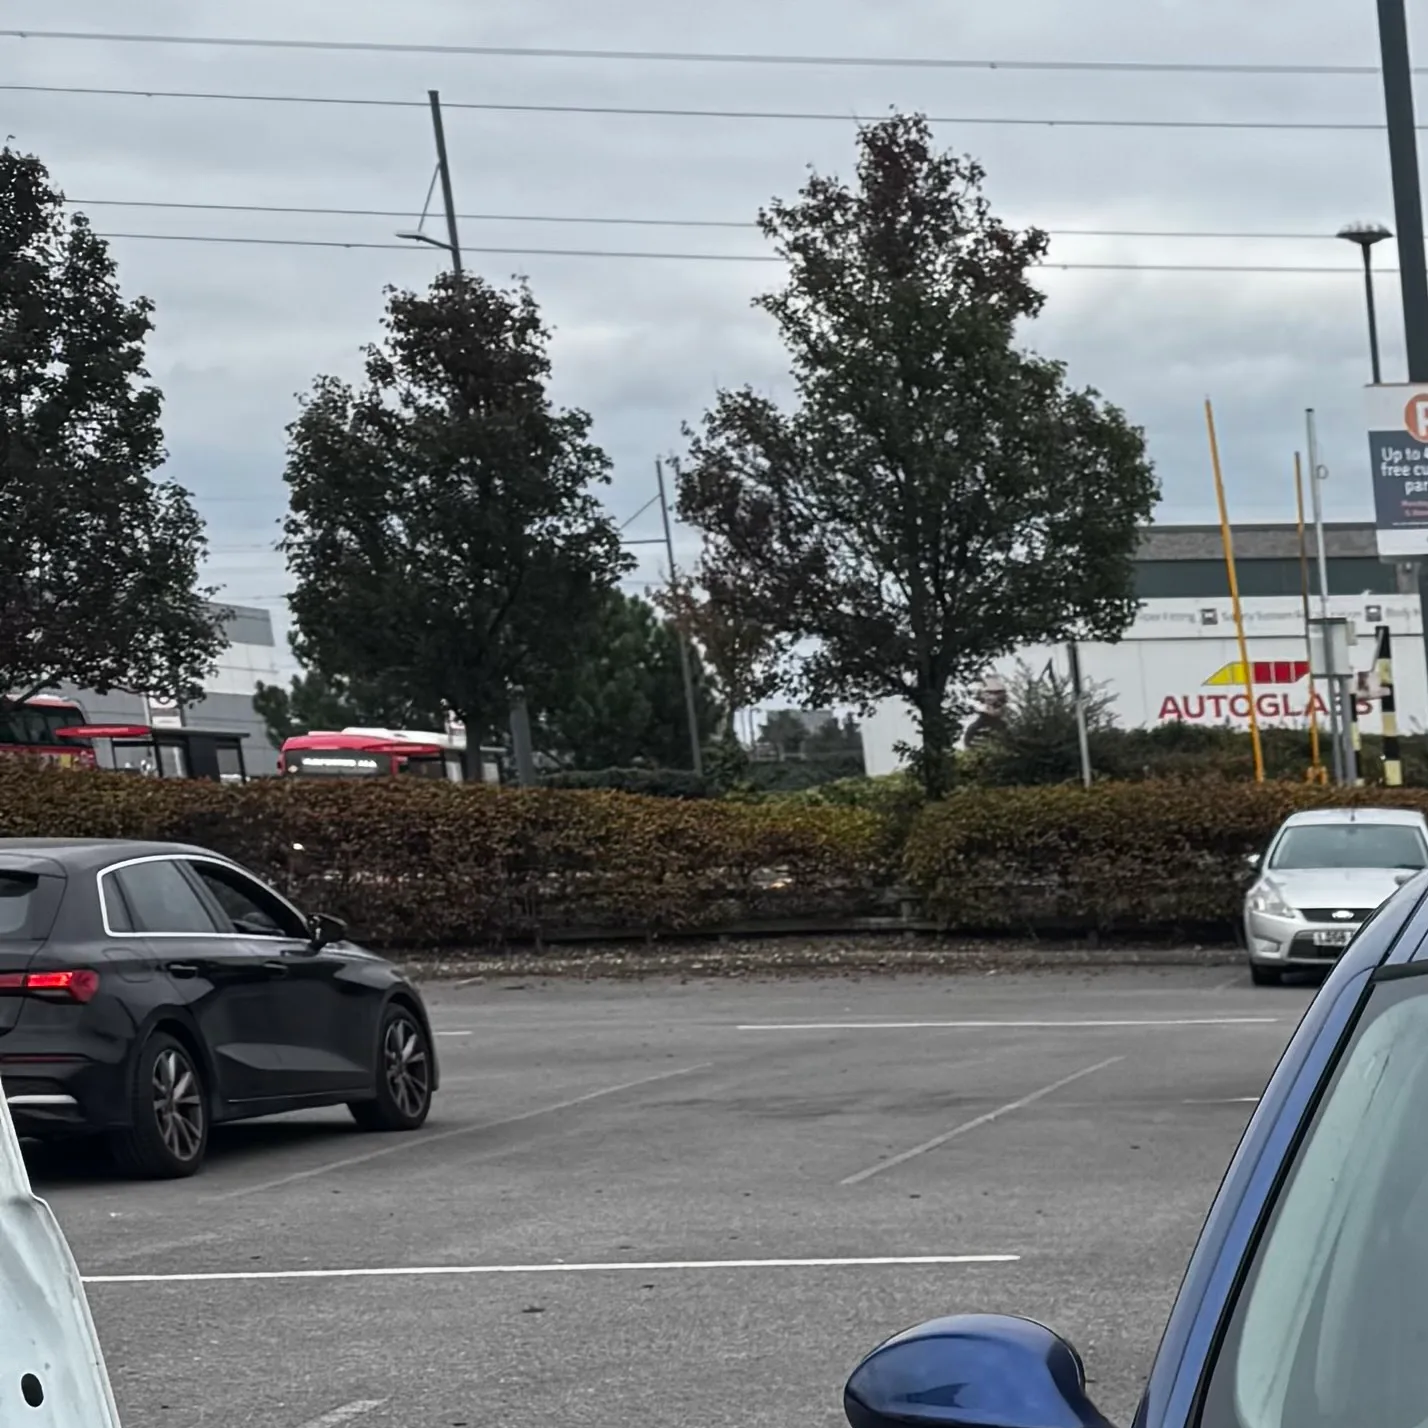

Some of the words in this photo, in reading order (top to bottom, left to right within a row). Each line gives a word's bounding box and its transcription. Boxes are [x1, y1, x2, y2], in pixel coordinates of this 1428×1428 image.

[1381, 446, 1402, 463] Up
[1405, 447, 1421, 460] to
[1381, 462, 1411, 476] free
[1159, 691, 1373, 718] AUTOGLAS
